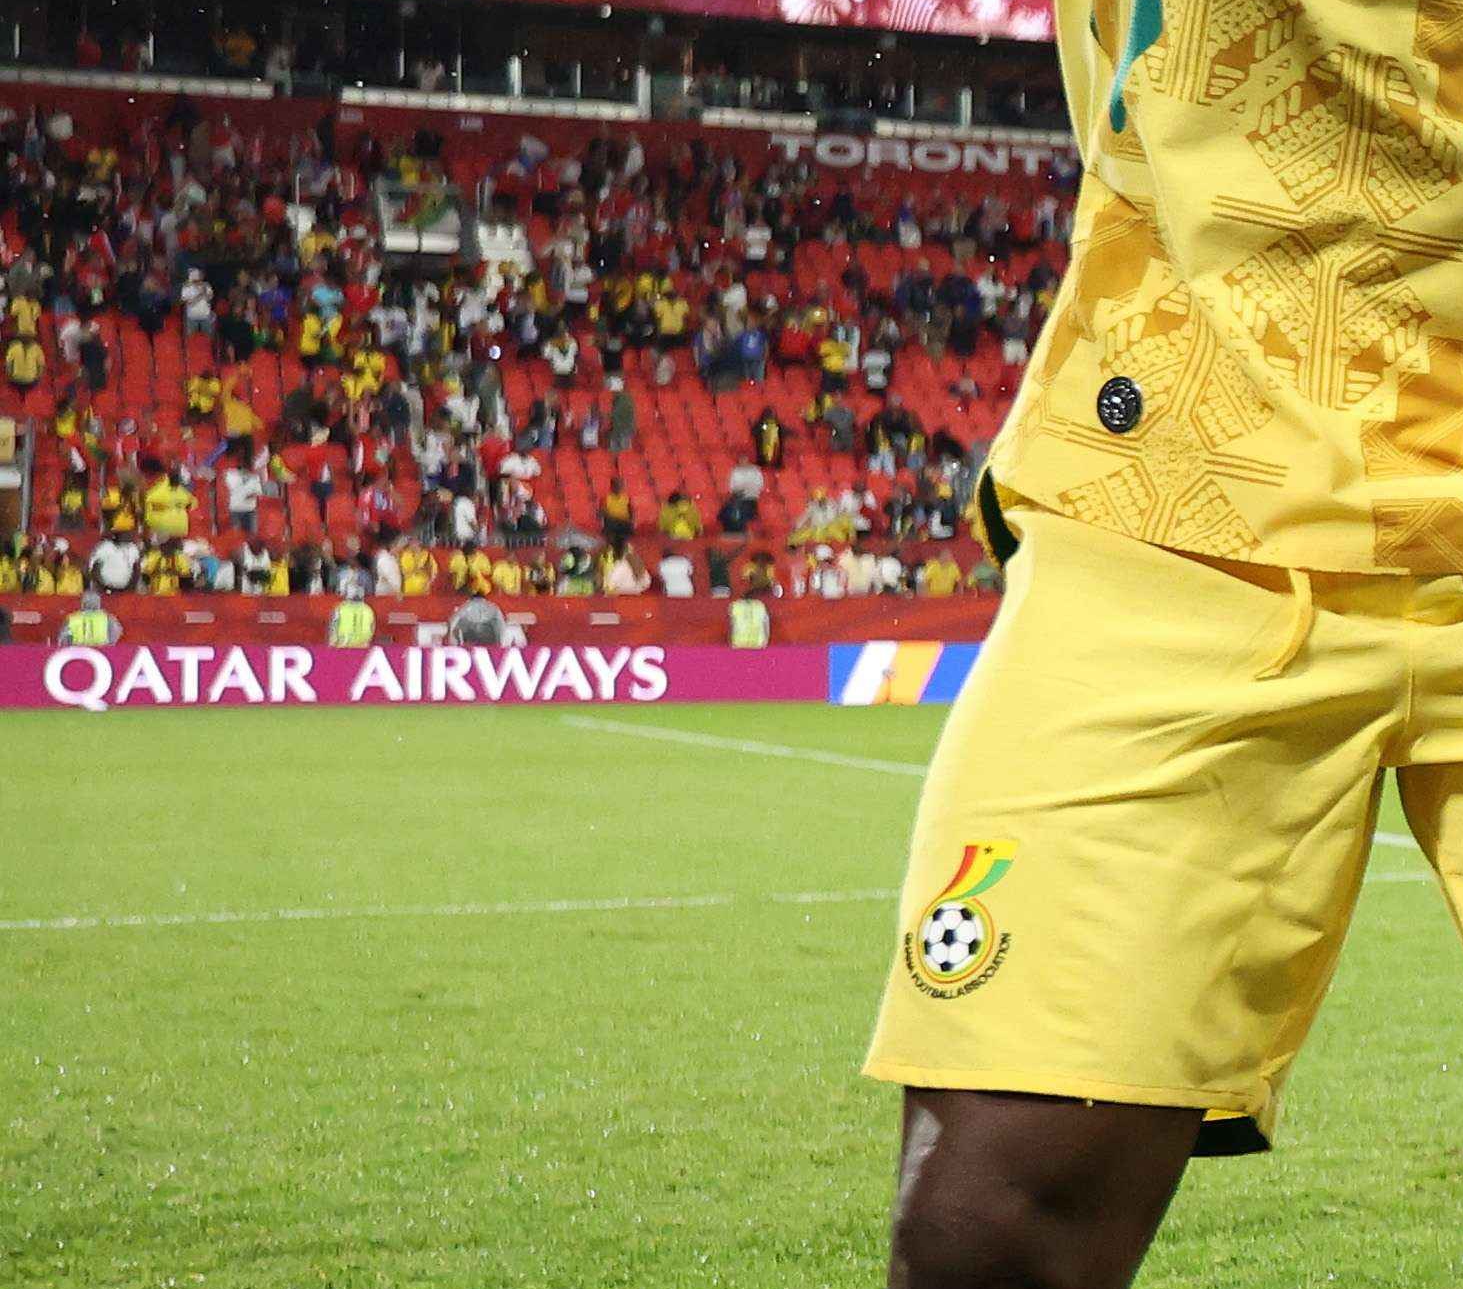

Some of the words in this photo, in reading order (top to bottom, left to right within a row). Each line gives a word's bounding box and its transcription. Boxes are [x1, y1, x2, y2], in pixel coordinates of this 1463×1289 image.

[770, 131, 1078, 175] TORONT
[44, 645, 318, 711] QATAR
[350, 645, 669, 702] AIRWAYS
